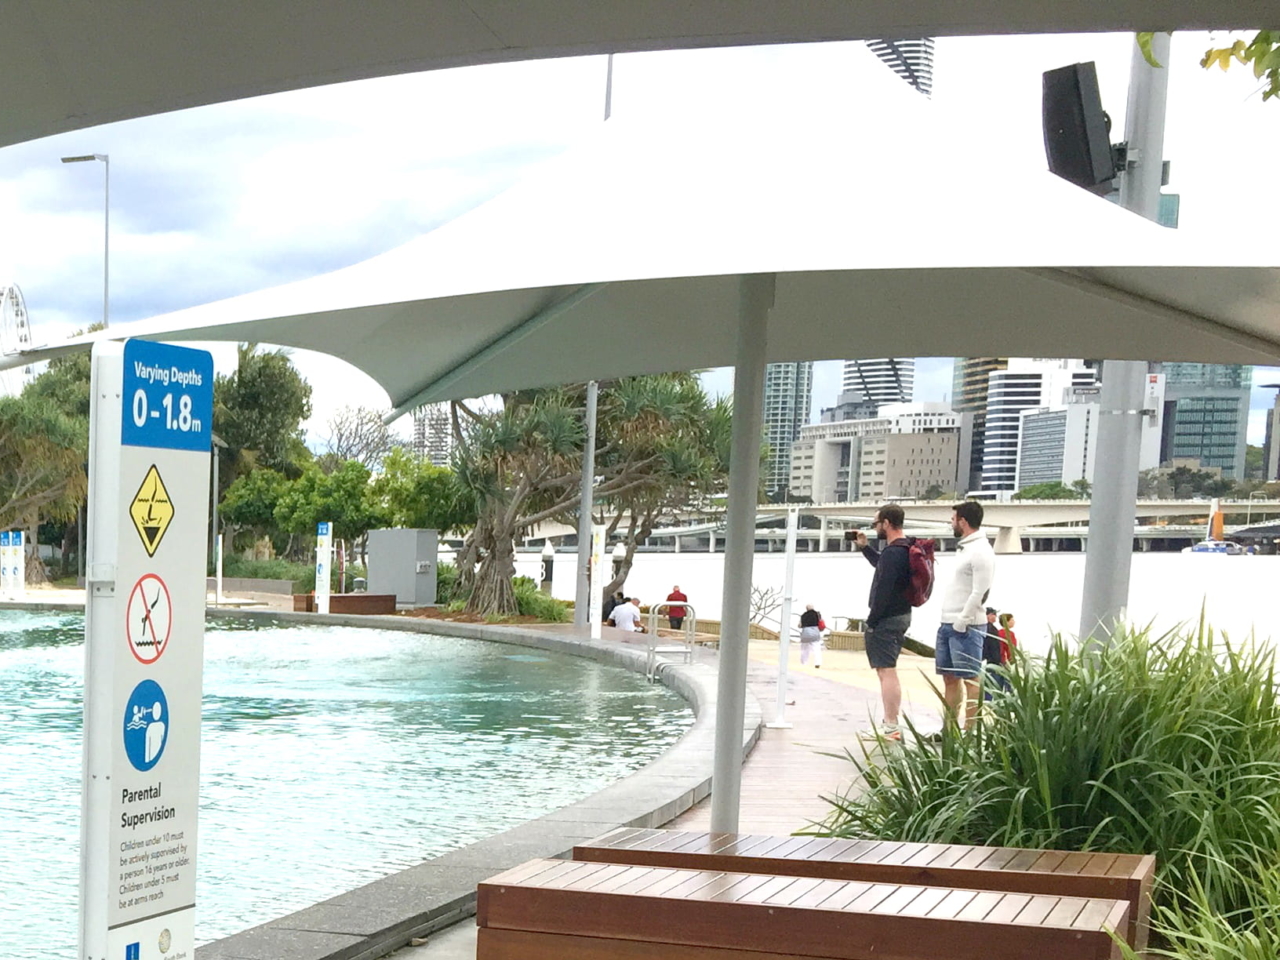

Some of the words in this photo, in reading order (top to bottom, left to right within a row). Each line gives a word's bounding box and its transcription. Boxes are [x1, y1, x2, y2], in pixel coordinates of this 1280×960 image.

[134, 361, 170, 386] Varying
[170, 366, 202, 388] Depths
[122, 781, 161, 804] Parental
[121, 805, 175, 830] Supervision
[120, 839, 145, 852] Children
[145, 835, 161, 847] under
[163, 832, 169, 842] 10
[170, 831, 184, 841] must
[120, 857, 127, 866] be
[129, 851, 149, 864] actively
[151, 843, 180, 860] supervised
[180, 843, 187, 854] by
[120, 873, 124, 881] a
[124, 869, 144, 882] person
[145, 865, 152, 874] 16
[153, 863, 167, 875] years
[168, 861, 174, 869] or
[119, 882, 144, 895] Children
[144, 877, 160, 888] under
[161, 874, 166, 884] 5
[166, 872, 179, 882] must
[119, 899, 127, 909] be
[127, 898, 134, 907] at
[134, 895, 148, 905] arms
[149, 889, 164, 901] reach
